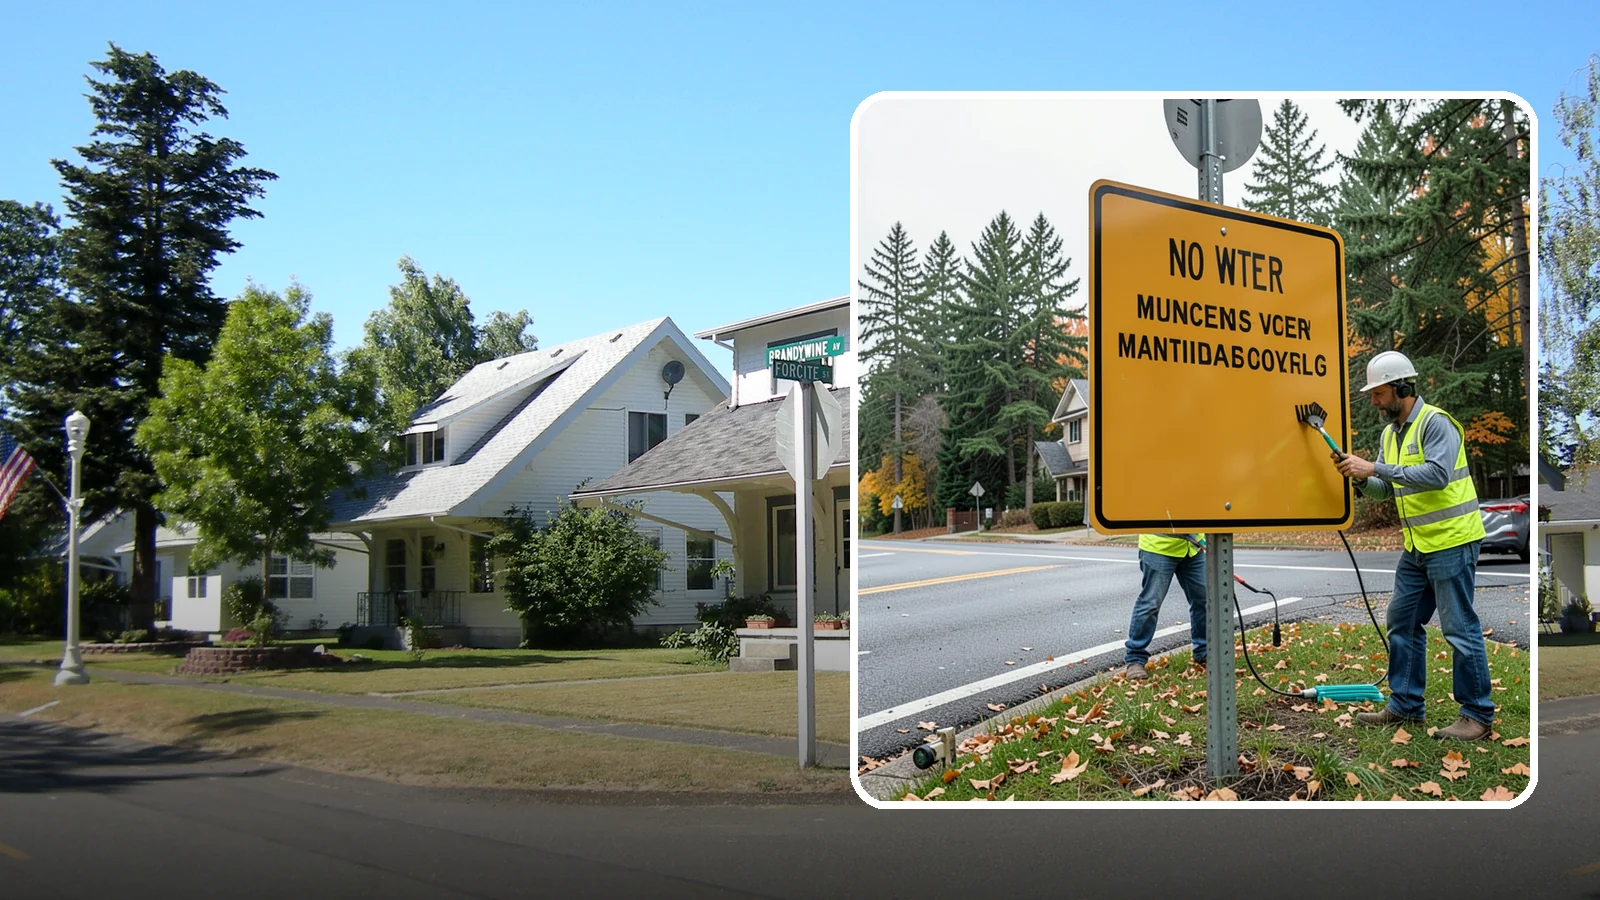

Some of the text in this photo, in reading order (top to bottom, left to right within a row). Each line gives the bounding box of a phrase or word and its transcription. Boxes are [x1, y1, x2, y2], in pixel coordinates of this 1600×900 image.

[1169, 237, 1284, 294] NO WTER
[1137, 293, 1252, 333] MUNCENS
[768, 340, 841, 364] BRANDYWINE AV
[775, 361, 830, 380] FORCITE ST
